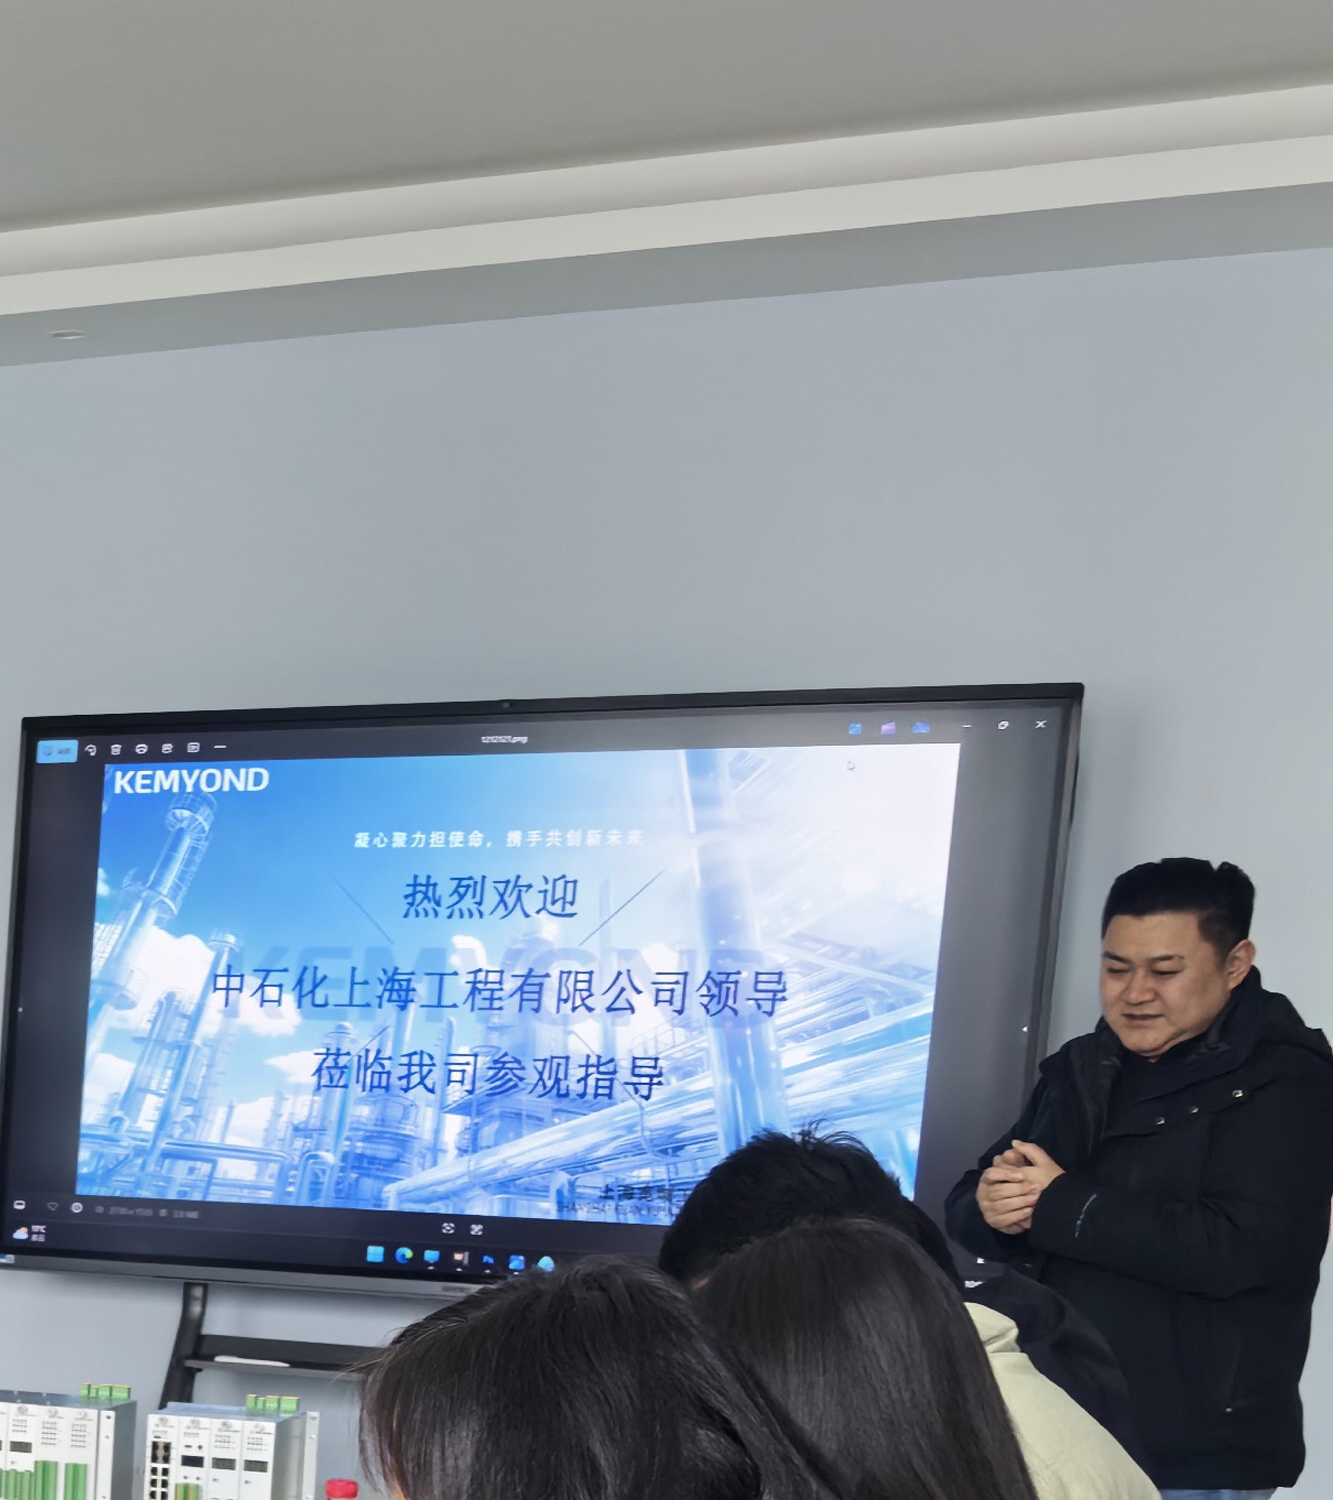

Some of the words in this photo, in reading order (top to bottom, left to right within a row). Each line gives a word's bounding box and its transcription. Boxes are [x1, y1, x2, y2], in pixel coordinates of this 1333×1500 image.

[113, 766, 271, 795] KEMYOND
[401, 873, 580, 920] 热烈欢迎
[210, 963, 790, 1019] 中石化上海工程有限公司领导
[310, 1046, 666, 1102] 莅临我司参观指导
